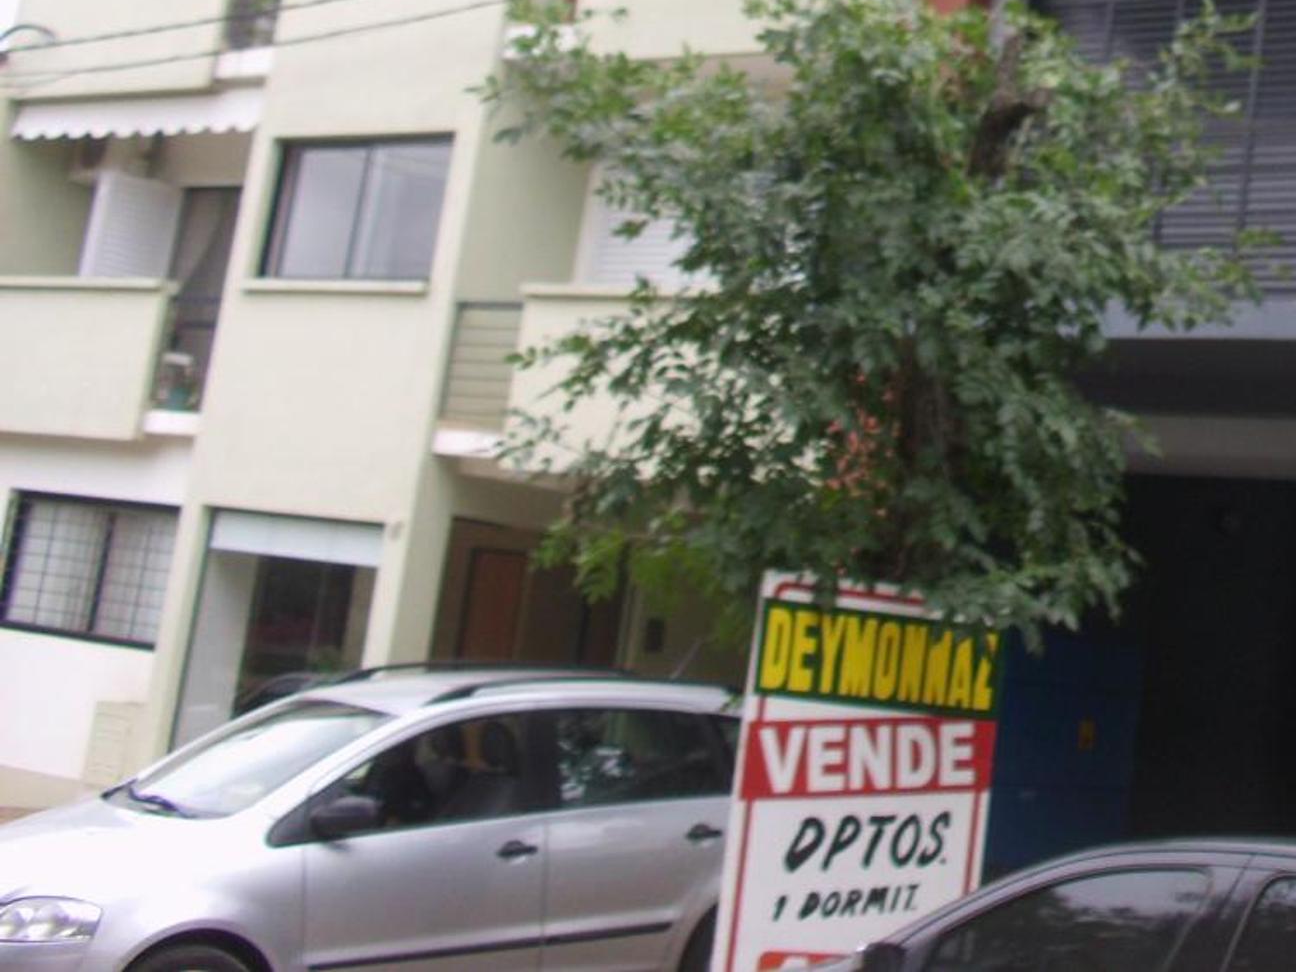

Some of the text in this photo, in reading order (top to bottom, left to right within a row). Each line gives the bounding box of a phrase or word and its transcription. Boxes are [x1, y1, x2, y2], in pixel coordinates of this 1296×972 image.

[759, 723, 975, 793] VENDE
[783, 811, 951, 873] DPTOS.
[771, 894, 788, 922] 1
